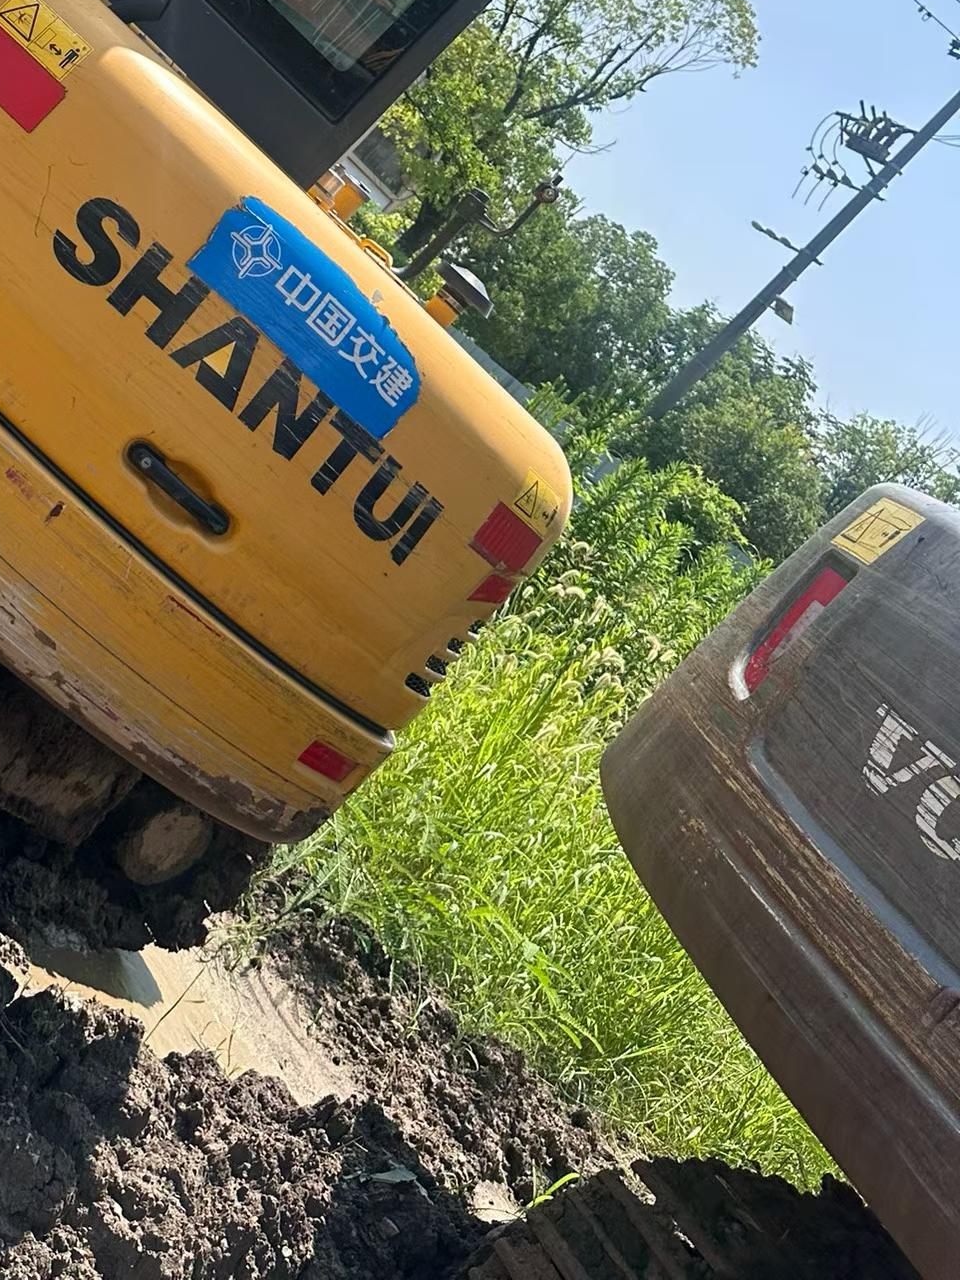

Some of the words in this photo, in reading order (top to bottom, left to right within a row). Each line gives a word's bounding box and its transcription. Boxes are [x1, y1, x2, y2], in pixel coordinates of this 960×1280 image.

[53, 197, 444, 566] SHANTUI
[275, 264, 413, 407] 中国交建
